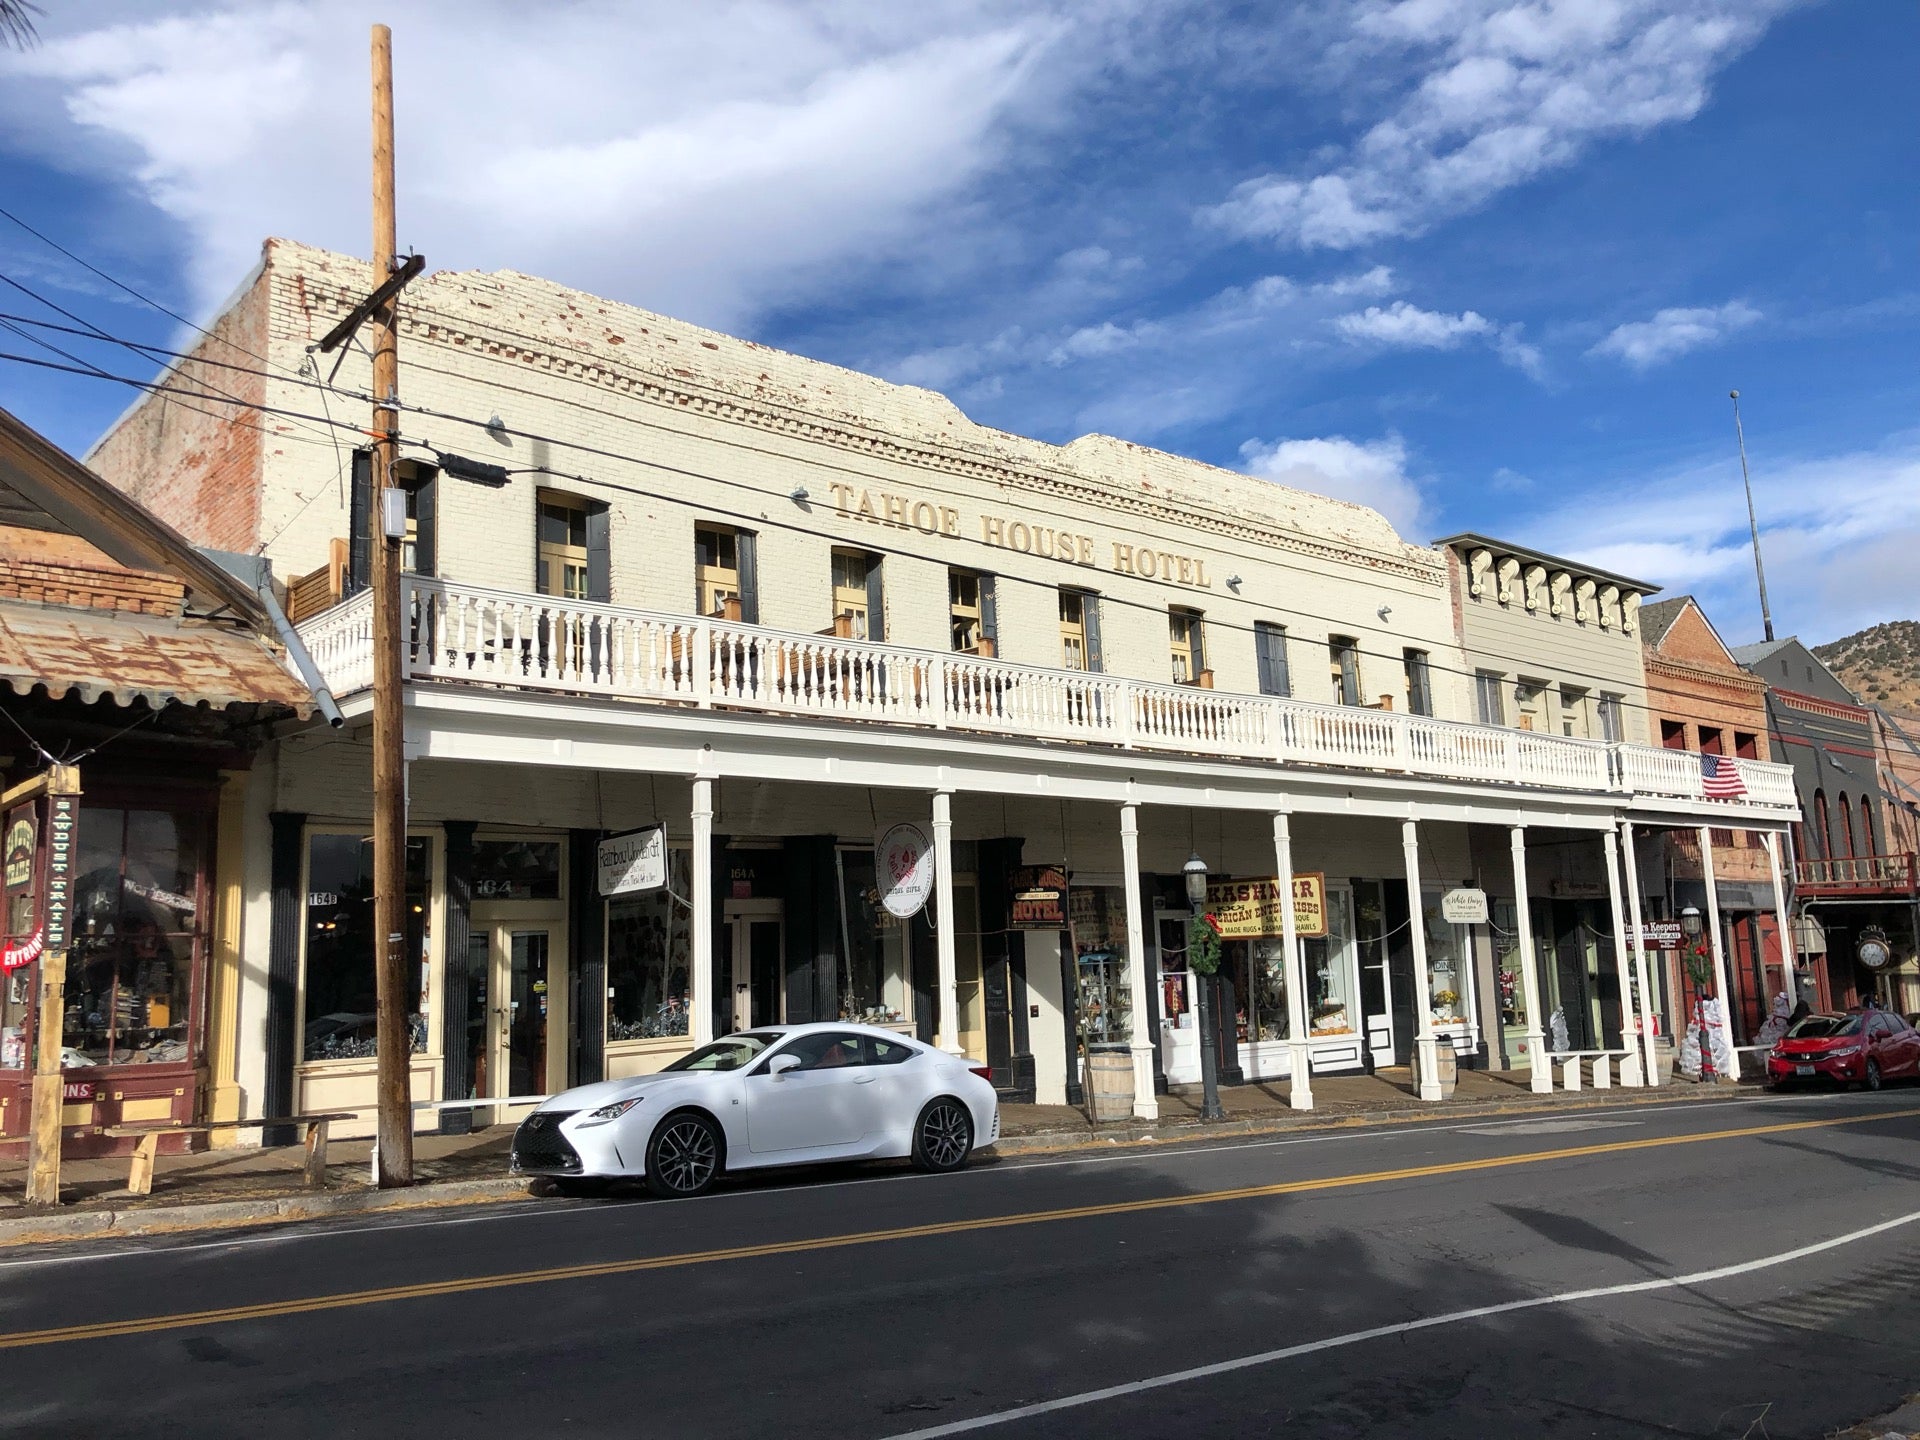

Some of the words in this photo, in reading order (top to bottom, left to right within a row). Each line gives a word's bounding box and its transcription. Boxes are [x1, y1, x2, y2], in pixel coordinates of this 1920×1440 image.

[829, 482, 961, 540] TAHOE
[980, 514, 1096, 566] HOUSE
[1111, 541, 1211, 588] HOTEL
[52, 801, 72, 873] SAWDUST
[49, 881, 67, 942] TRAILS
[1013, 900, 1065, 920] HOTEL
[1207, 909, 1252, 922] ERICAN
[1255, 901, 1319, 918] ENTERISES
[1650, 921, 1681, 933] Keepers
[4, 927, 43, 966] ENTRANC
